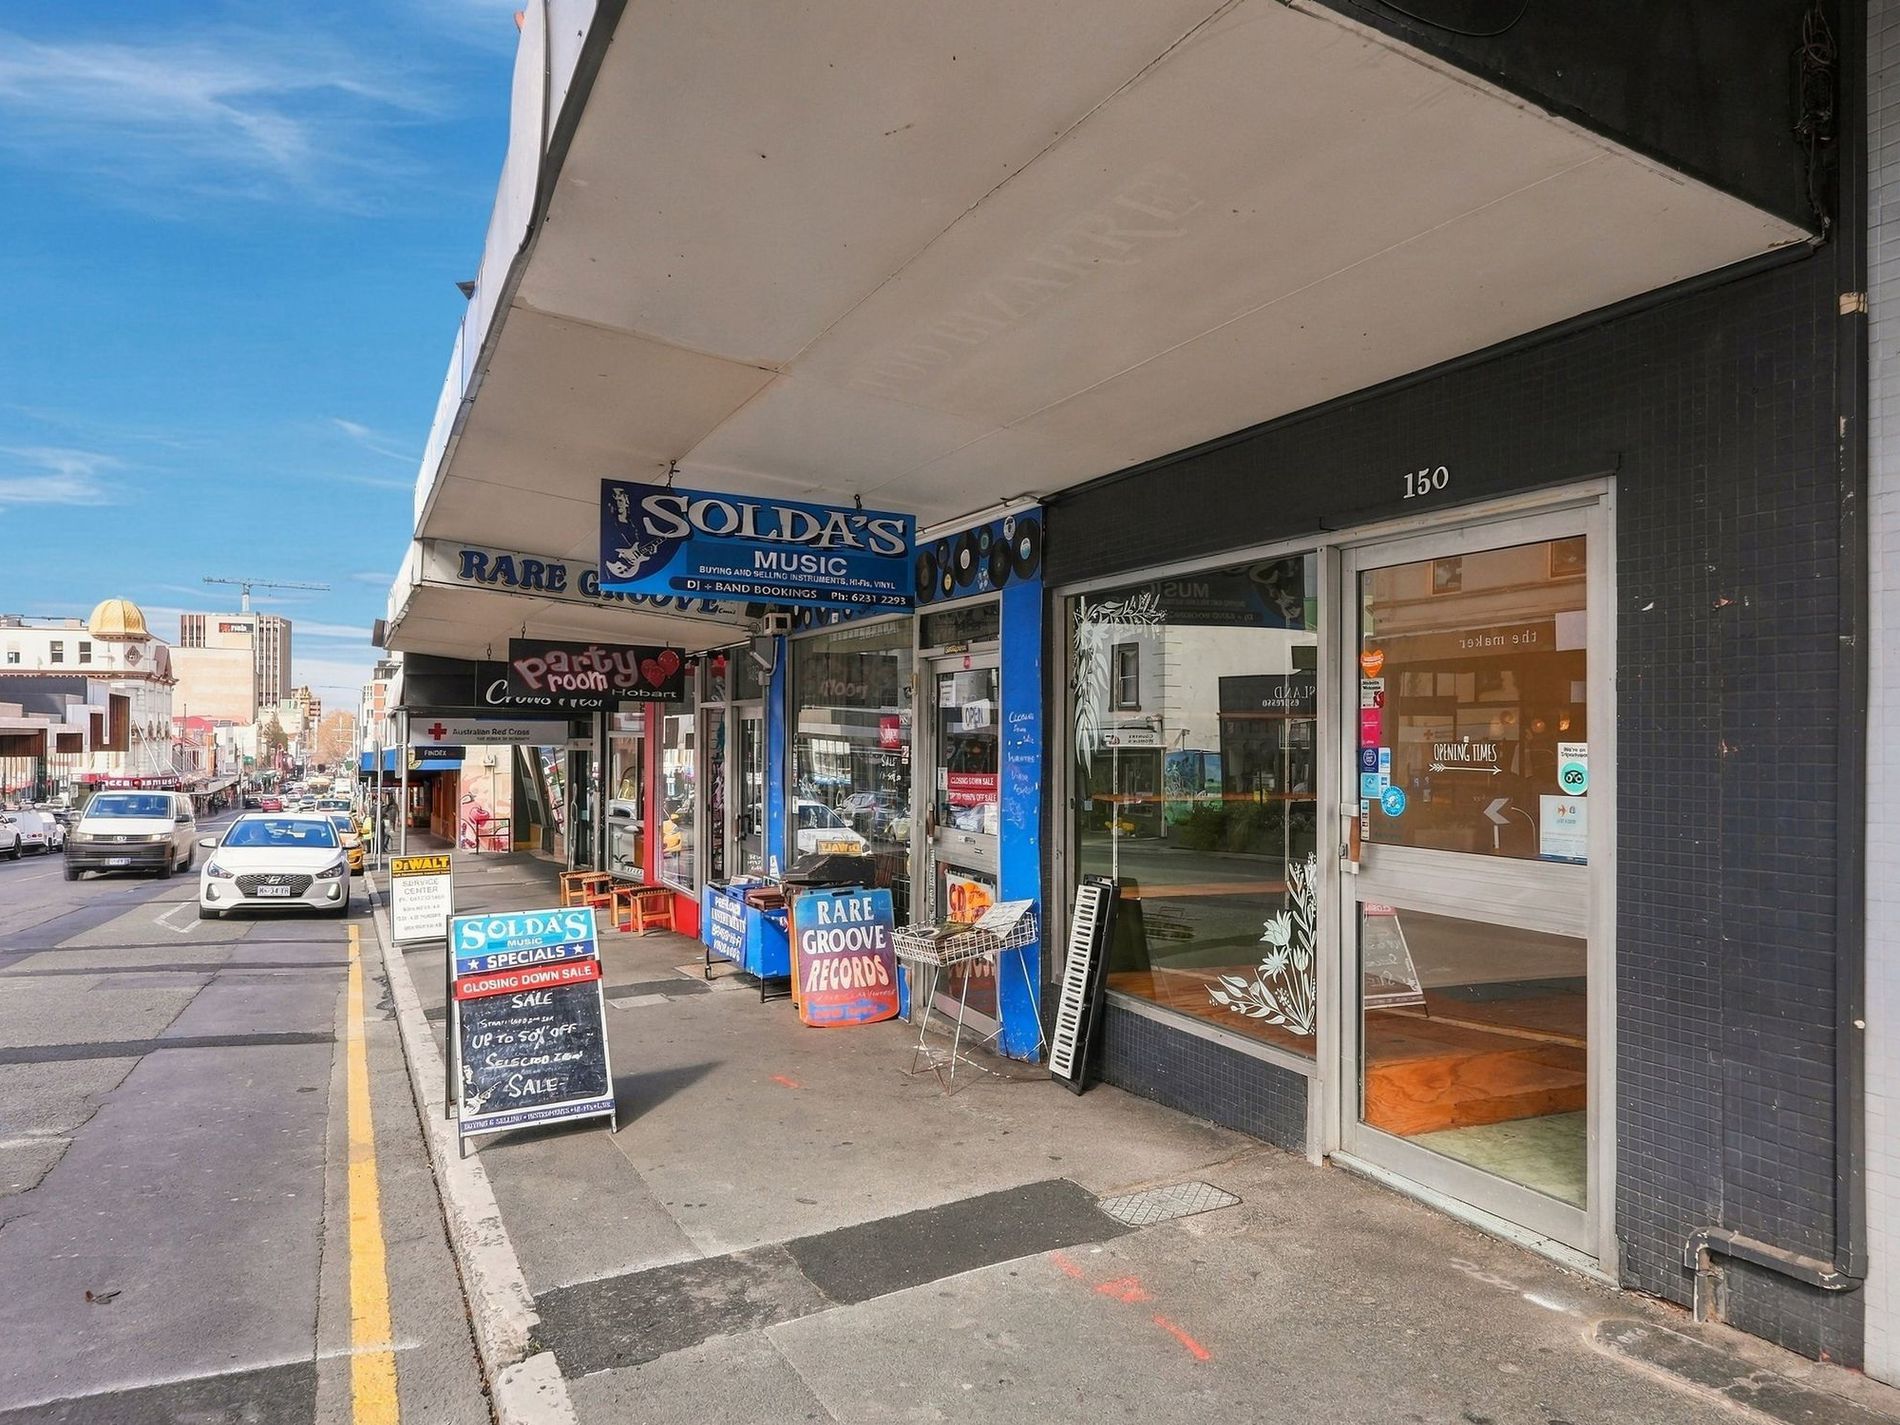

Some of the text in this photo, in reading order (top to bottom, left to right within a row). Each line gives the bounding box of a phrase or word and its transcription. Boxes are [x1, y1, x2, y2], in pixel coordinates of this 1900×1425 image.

[1403, 466, 1449, 499] 150
[641, 494, 906, 556] SOLDA'S
[457, 550, 568, 593] RARE
[754, 550, 847, 576] MUSIC
[699, 565, 732, 576] BUYING
[733, 568, 751, 577] AND
[754, 570, 787, 580] SELLING
[874, 580, 896, 589] VINYL
[687, 580, 699, 591] DJ
[715, 582, 750, 593] BAND
[754, 585, 817, 599] BOOKINGS
[831, 592, 848, 602] Ph:
[851, 593, 877, 603] 6231
[881, 595, 907, 605] 2293
[513, 649, 638, 689] party
[548, 670, 608, 693] room
[611, 687, 677, 698] Hobart
[452, 728, 530, 736] Australian Red Cross
[1433, 743, 1497, 762] OPENING TIMES
[982, 777, 994, 786] SALE
[817, 897, 874, 925] RARE
[461, 913, 588, 950] SOLDA'S
[506, 937, 543, 948] MUSIC
[802, 925, 887, 955] GROOVE
[487, 945, 565, 969] SPECIALS
[463, 965, 592, 993] CLOSING DOWN SALE
[805, 954, 890, 993] RECORDS
[511, 992, 553, 1009] SALE
[472, 1033, 493, 1049] UP
[496, 1033, 514, 1044] TO
[550, 1023, 577, 1037] OFF
